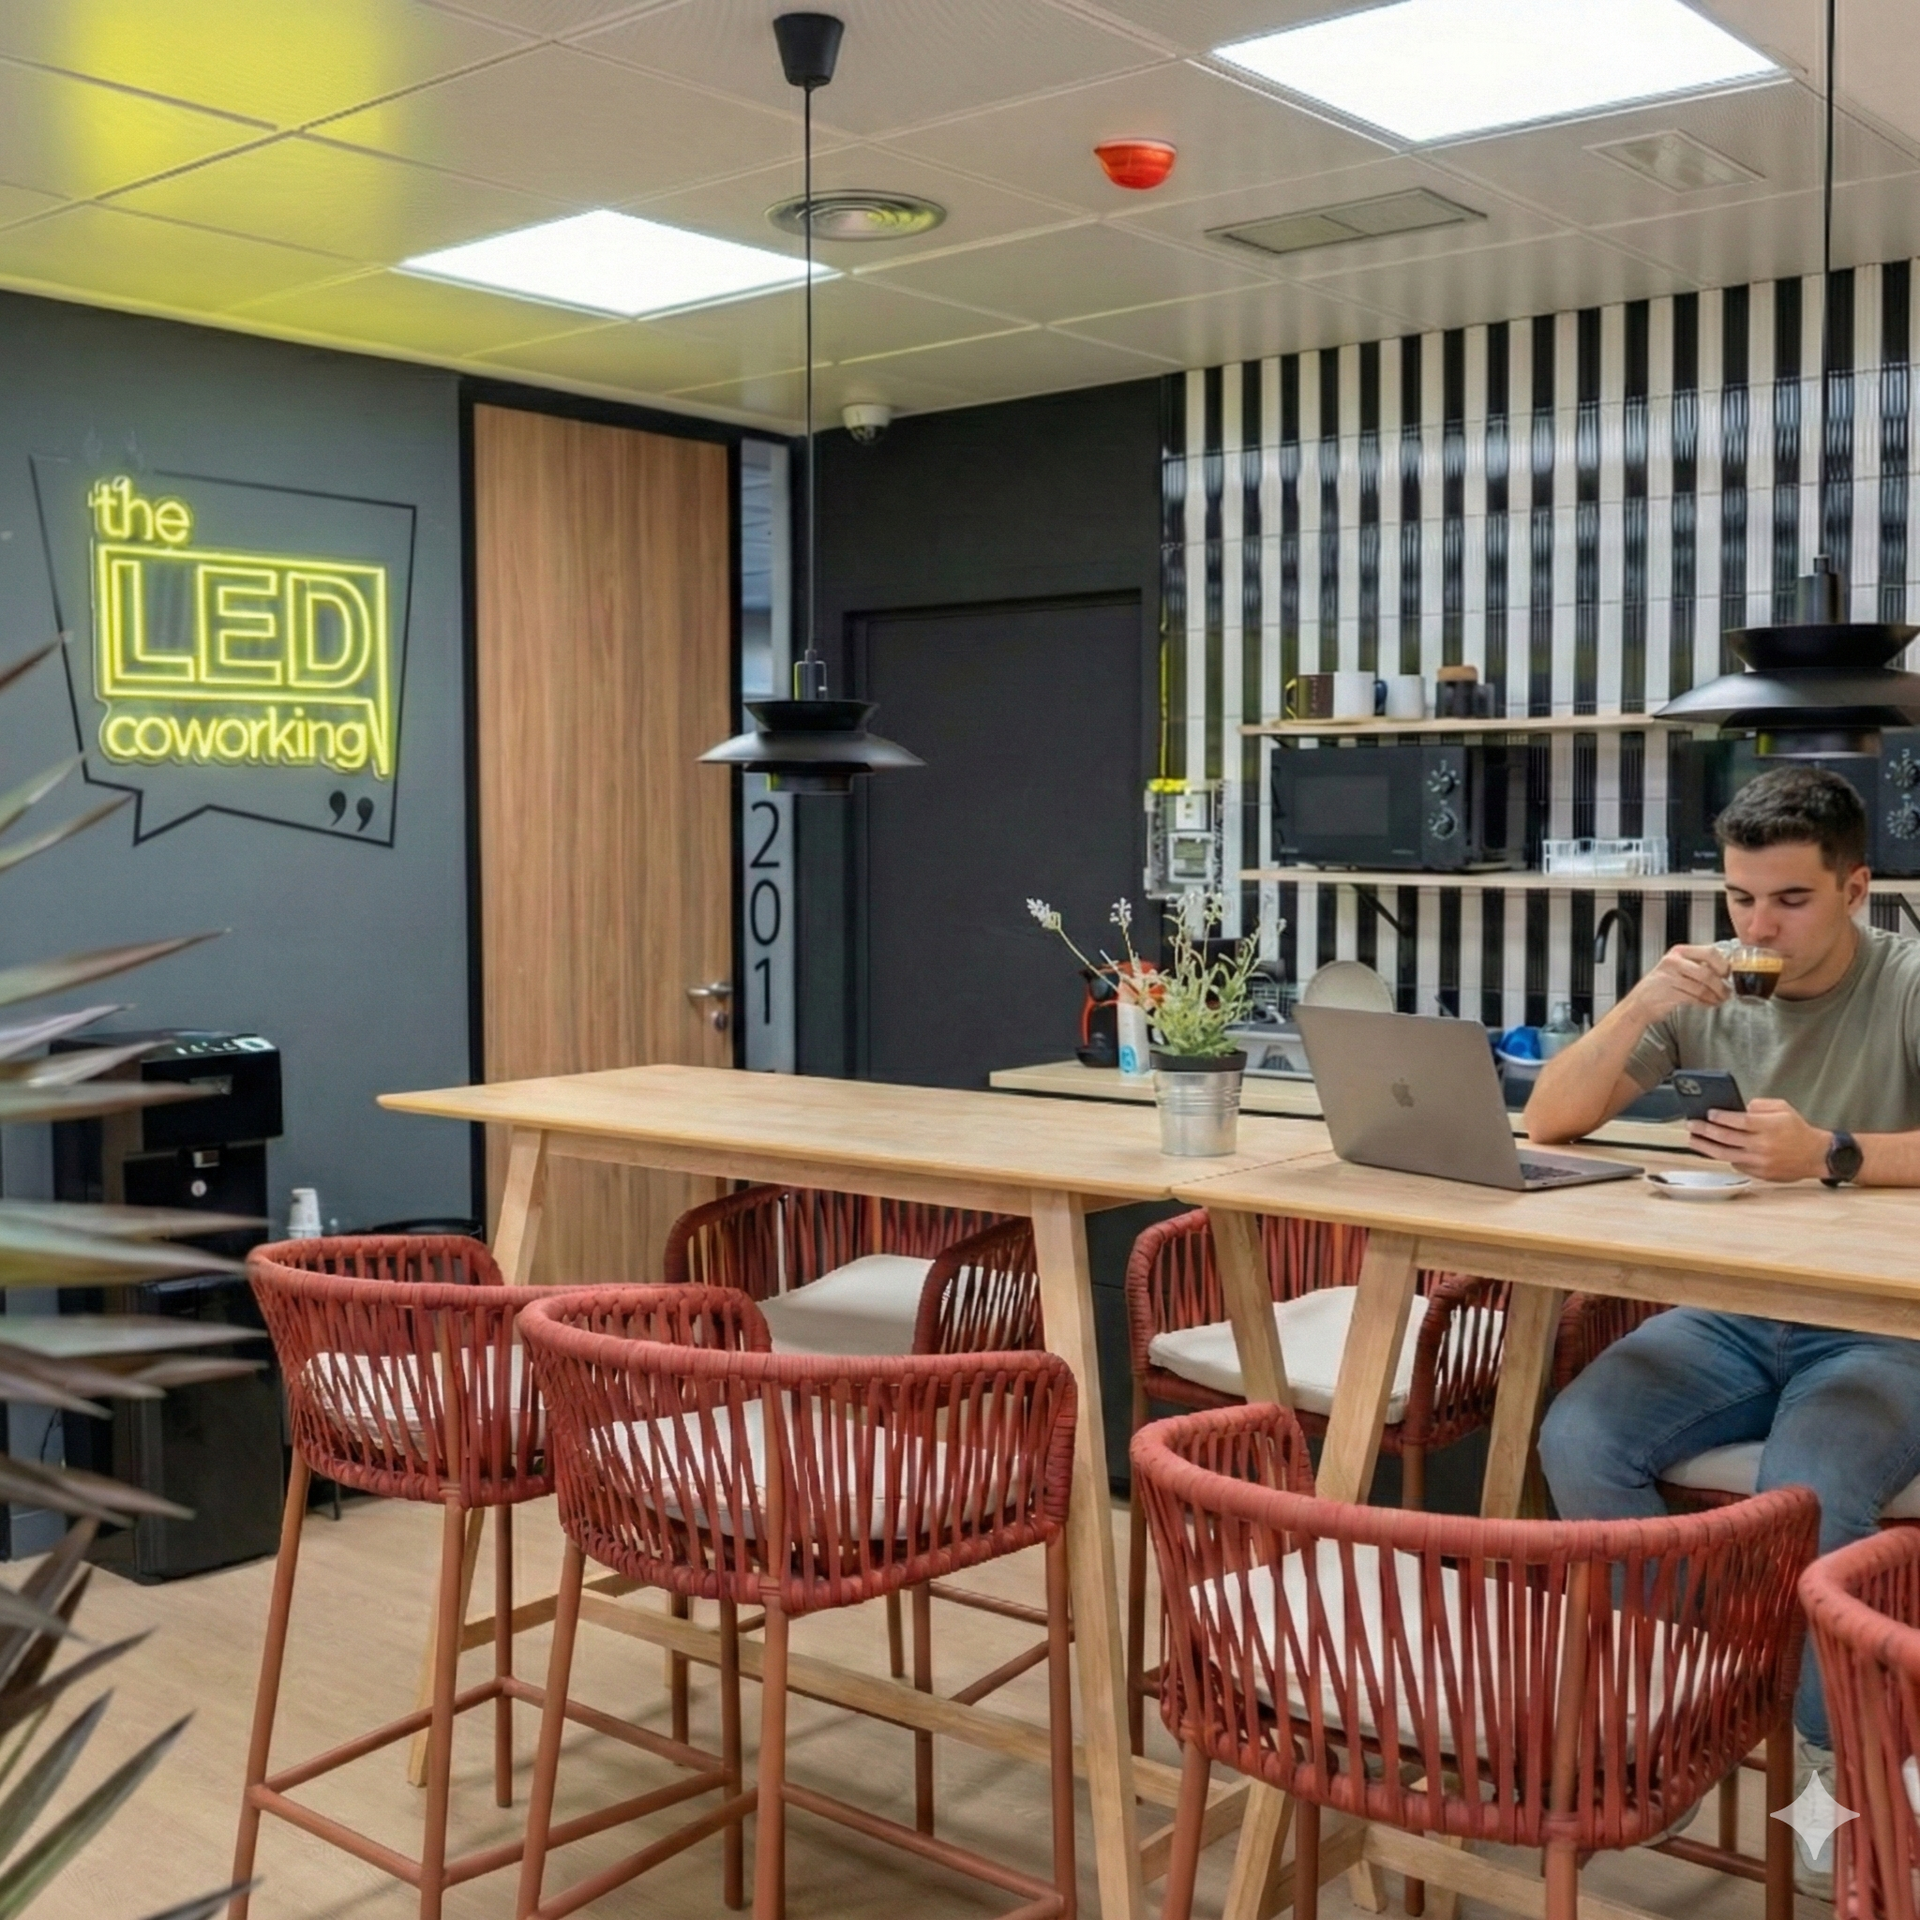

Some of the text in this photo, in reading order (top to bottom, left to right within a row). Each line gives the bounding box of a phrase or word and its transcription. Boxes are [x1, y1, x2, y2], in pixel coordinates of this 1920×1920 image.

[94, 478, 190, 543] the
[111, 559, 371, 690] LED
[105, 707, 368, 769] coworking
[749, 801, 781, 1025] 201
